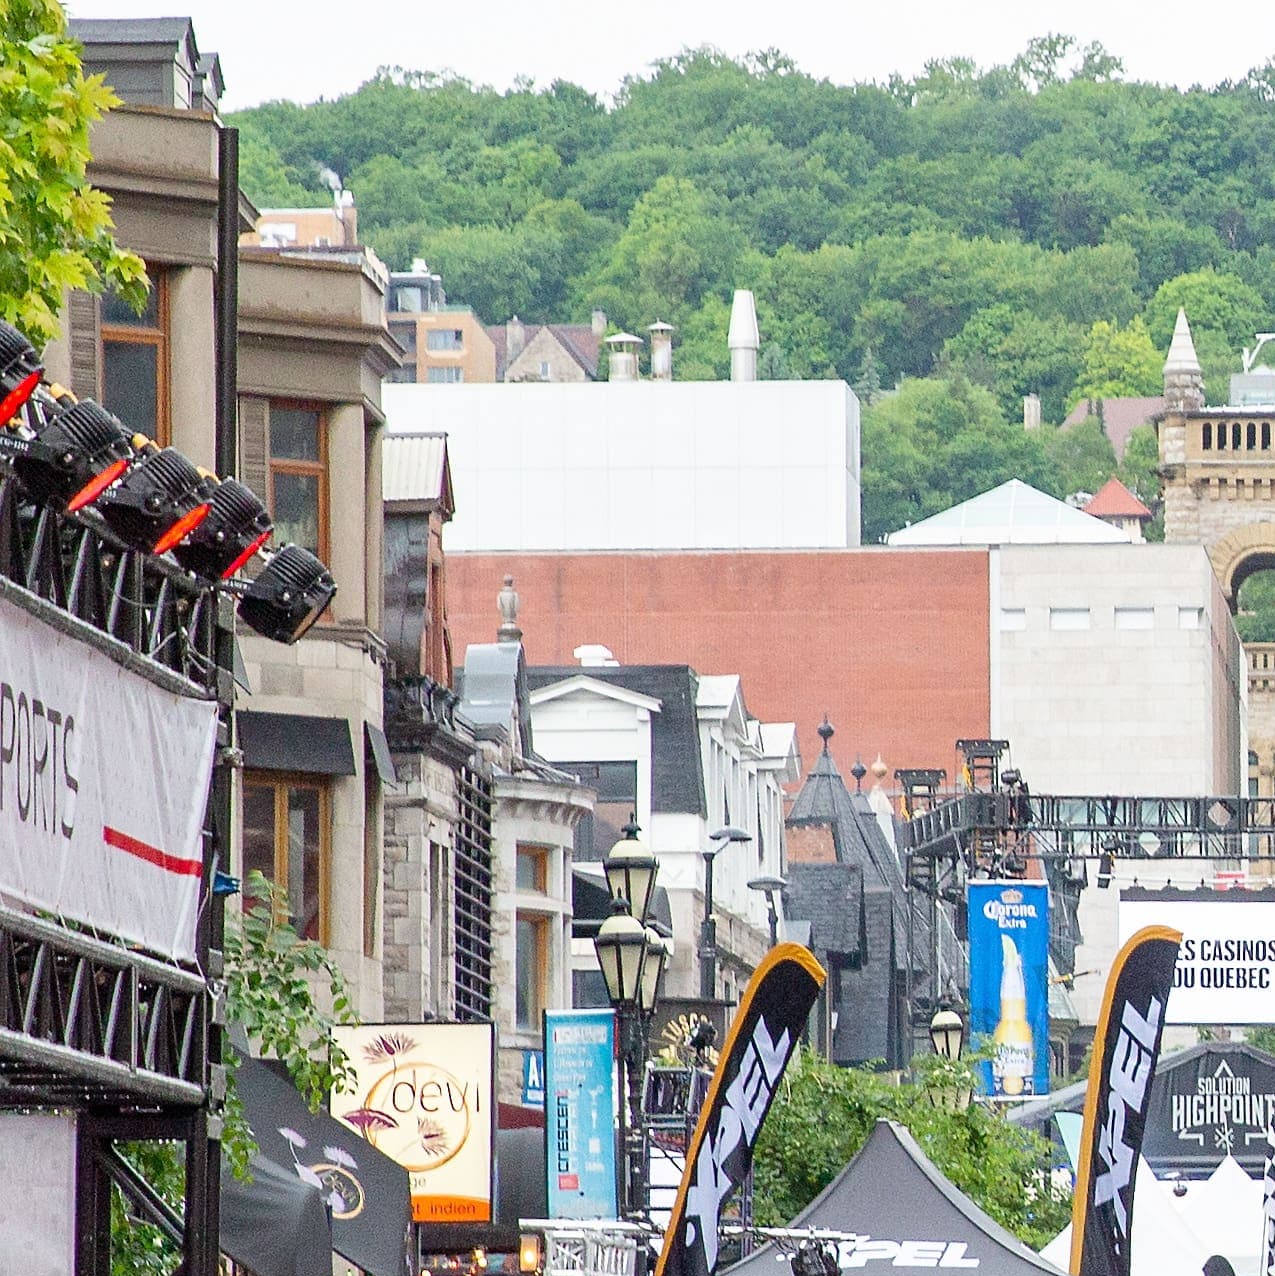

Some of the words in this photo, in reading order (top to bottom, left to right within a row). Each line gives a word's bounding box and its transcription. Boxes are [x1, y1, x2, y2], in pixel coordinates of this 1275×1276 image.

[983, 899, 1038, 921] Corona
[998, 916, 1027, 929] Extra
[1200, 967, 1271, 990] QUEBEC
[392, 1069, 480, 1113] devi
[1198, 1076, 1251, 1097] SOLUTION
[1095, 995, 1163, 1241] XPEL
[1171, 1093, 1275, 1132] HIGHPOINT
[684, 1014, 791, 1274] XPEL
[430, 1204, 476, 1215] indien
